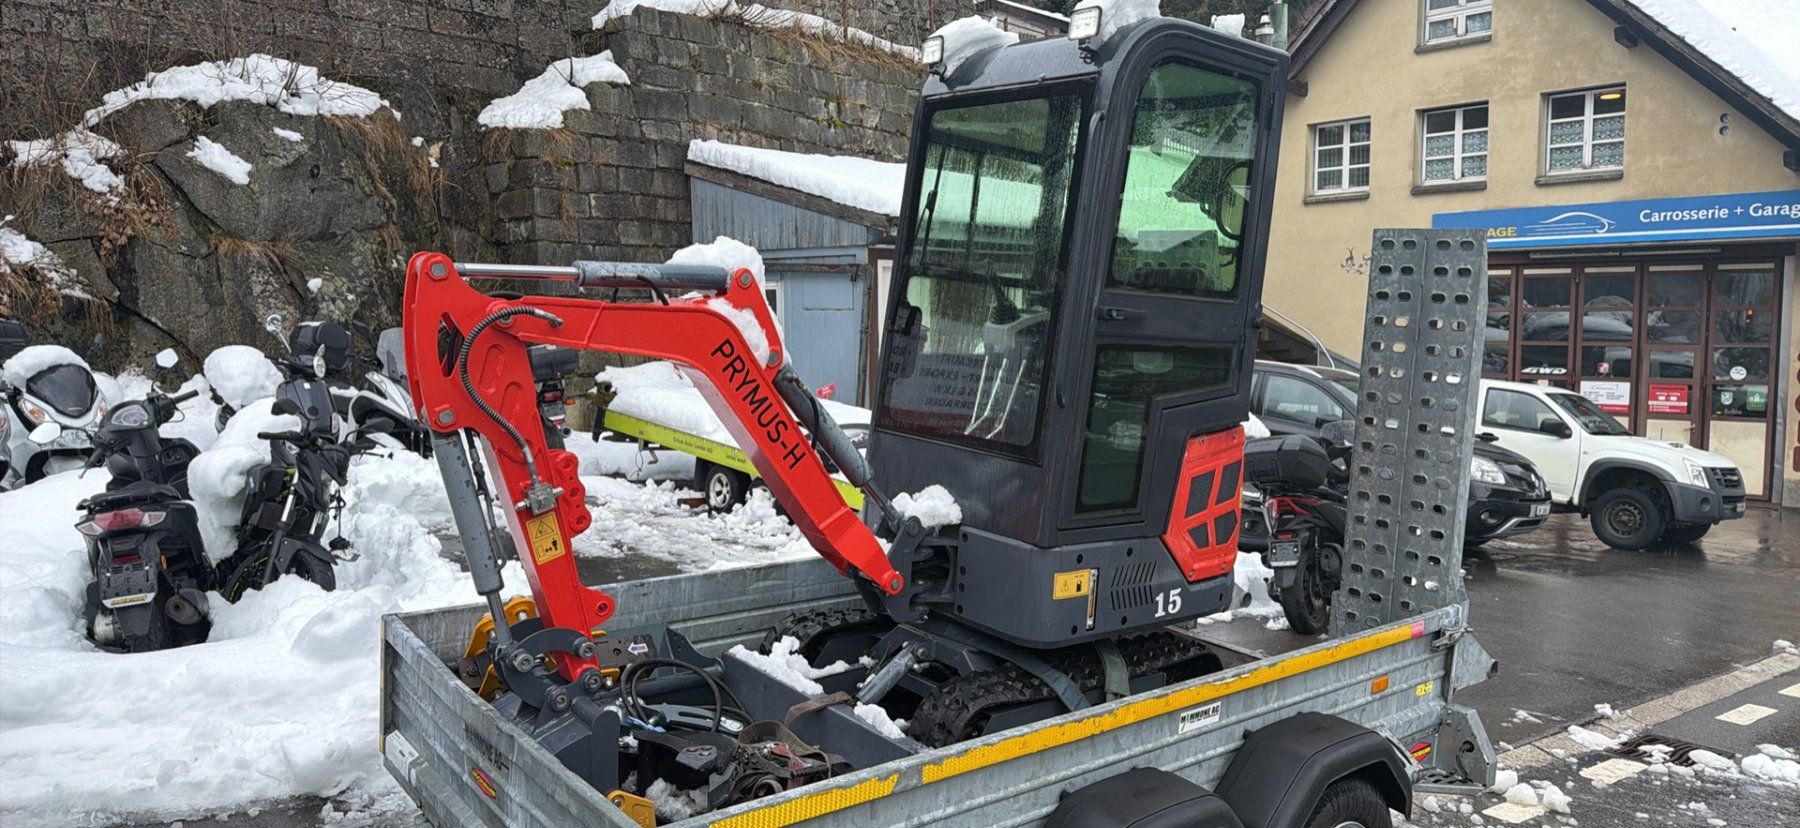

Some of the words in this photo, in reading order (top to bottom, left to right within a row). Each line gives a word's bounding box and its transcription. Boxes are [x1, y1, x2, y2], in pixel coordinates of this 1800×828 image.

[1639, 205, 1729, 223] Carrosserie
[1733, 206, 1745, 216] +
[1749, 203, 1800, 219] Garag
[1487, 226, 1518, 238] AGE
[711, 338, 806, 470] PRYMUS-H
[1154, 587, 1182, 618] 15
